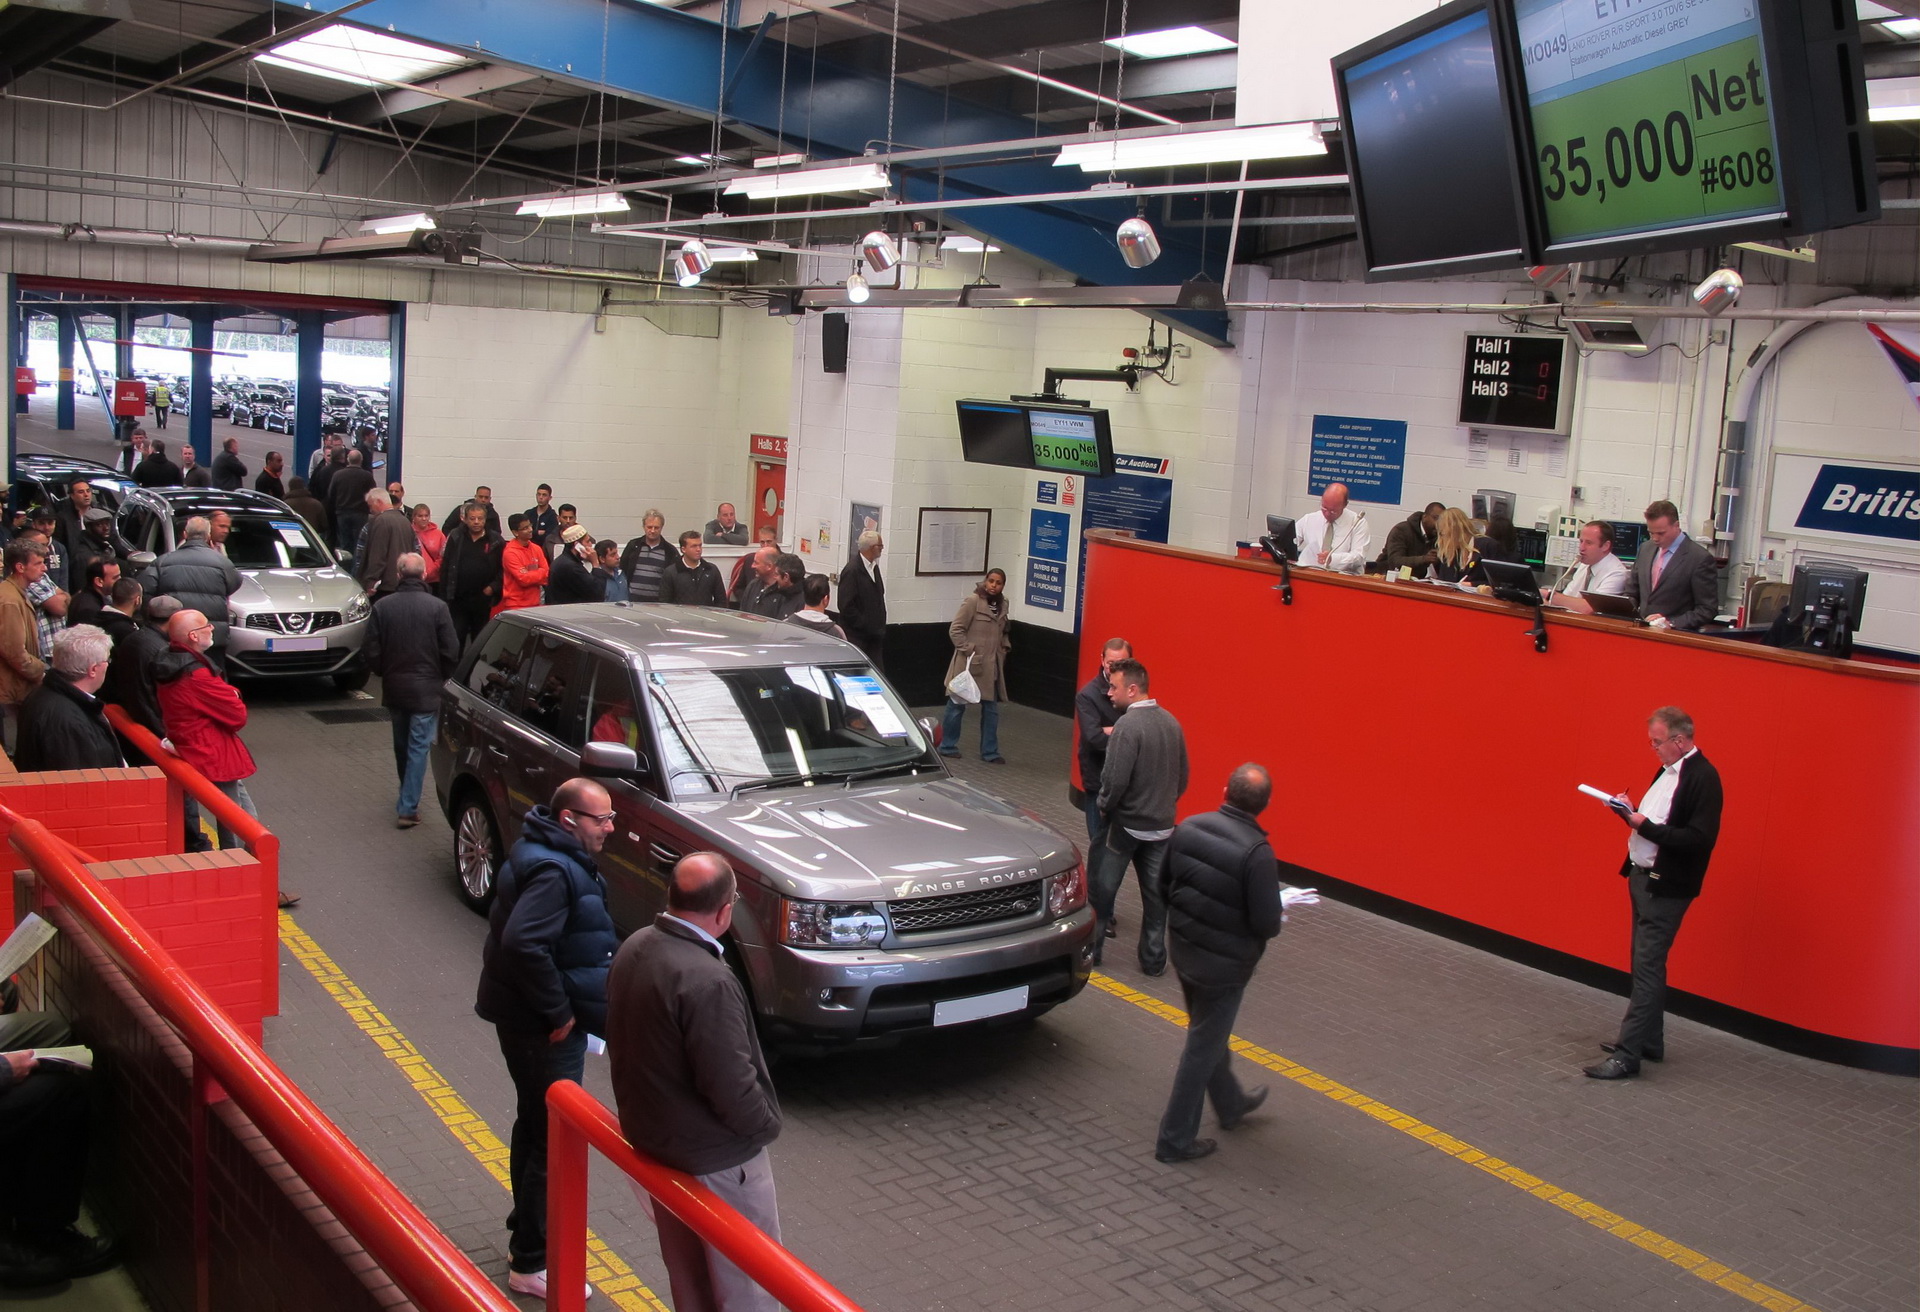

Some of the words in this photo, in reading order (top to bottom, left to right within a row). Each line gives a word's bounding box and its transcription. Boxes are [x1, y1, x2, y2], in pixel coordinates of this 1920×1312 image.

[1568, 40, 1586, 53] LAND
[1586, 29, 1610, 46] ROVER
[1625, 14, 1649, 31] SPORT
[1651, 9, 1663, 21] 3.0
[1663, 2, 1684, 16] TDV6
[1522, 33, 1568, 66] MO049
[1571, 46, 1611, 66] Stationwagon
[1612, 34, 1643, 52] Automatic
[1644, 24, 1666, 41] Diesel
[1667, 16, 1689, 32] GREY
[1690, 58, 1765, 120] Net
[1540, 110, 1695, 204] 35,000
[1699, 147, 1774, 195] #608
[1475, 337, 1502, 354] Hall
[1503, 339, 1511, 354] 1
[1473, 359, 1500, 375] Hall
[1500, 360, 1510, 376] 2
[1471, 380, 1498, 397] Hall
[1498, 381, 1508, 397] 3
[757, 438, 773, 450] Halls
[1034, 444, 1079, 461] 35,000
[1079, 443, 1097, 454] Net
[1080, 459, 1098, 468] #608
[1115, 457, 1128, 465] Car
[1128, 459, 1157, 469] Auctions
[1822, 483, 1920, 520] Britis
[1033, 562, 1050, 572] BUYERS
[1050, 566, 1059, 574] FEE
[1037, 582, 1062, 593] PURCHASES
[1051, 575, 1058, 583] ON
[893, 880, 966, 898] RANGE
[979, 867, 1038, 885] ROVER
